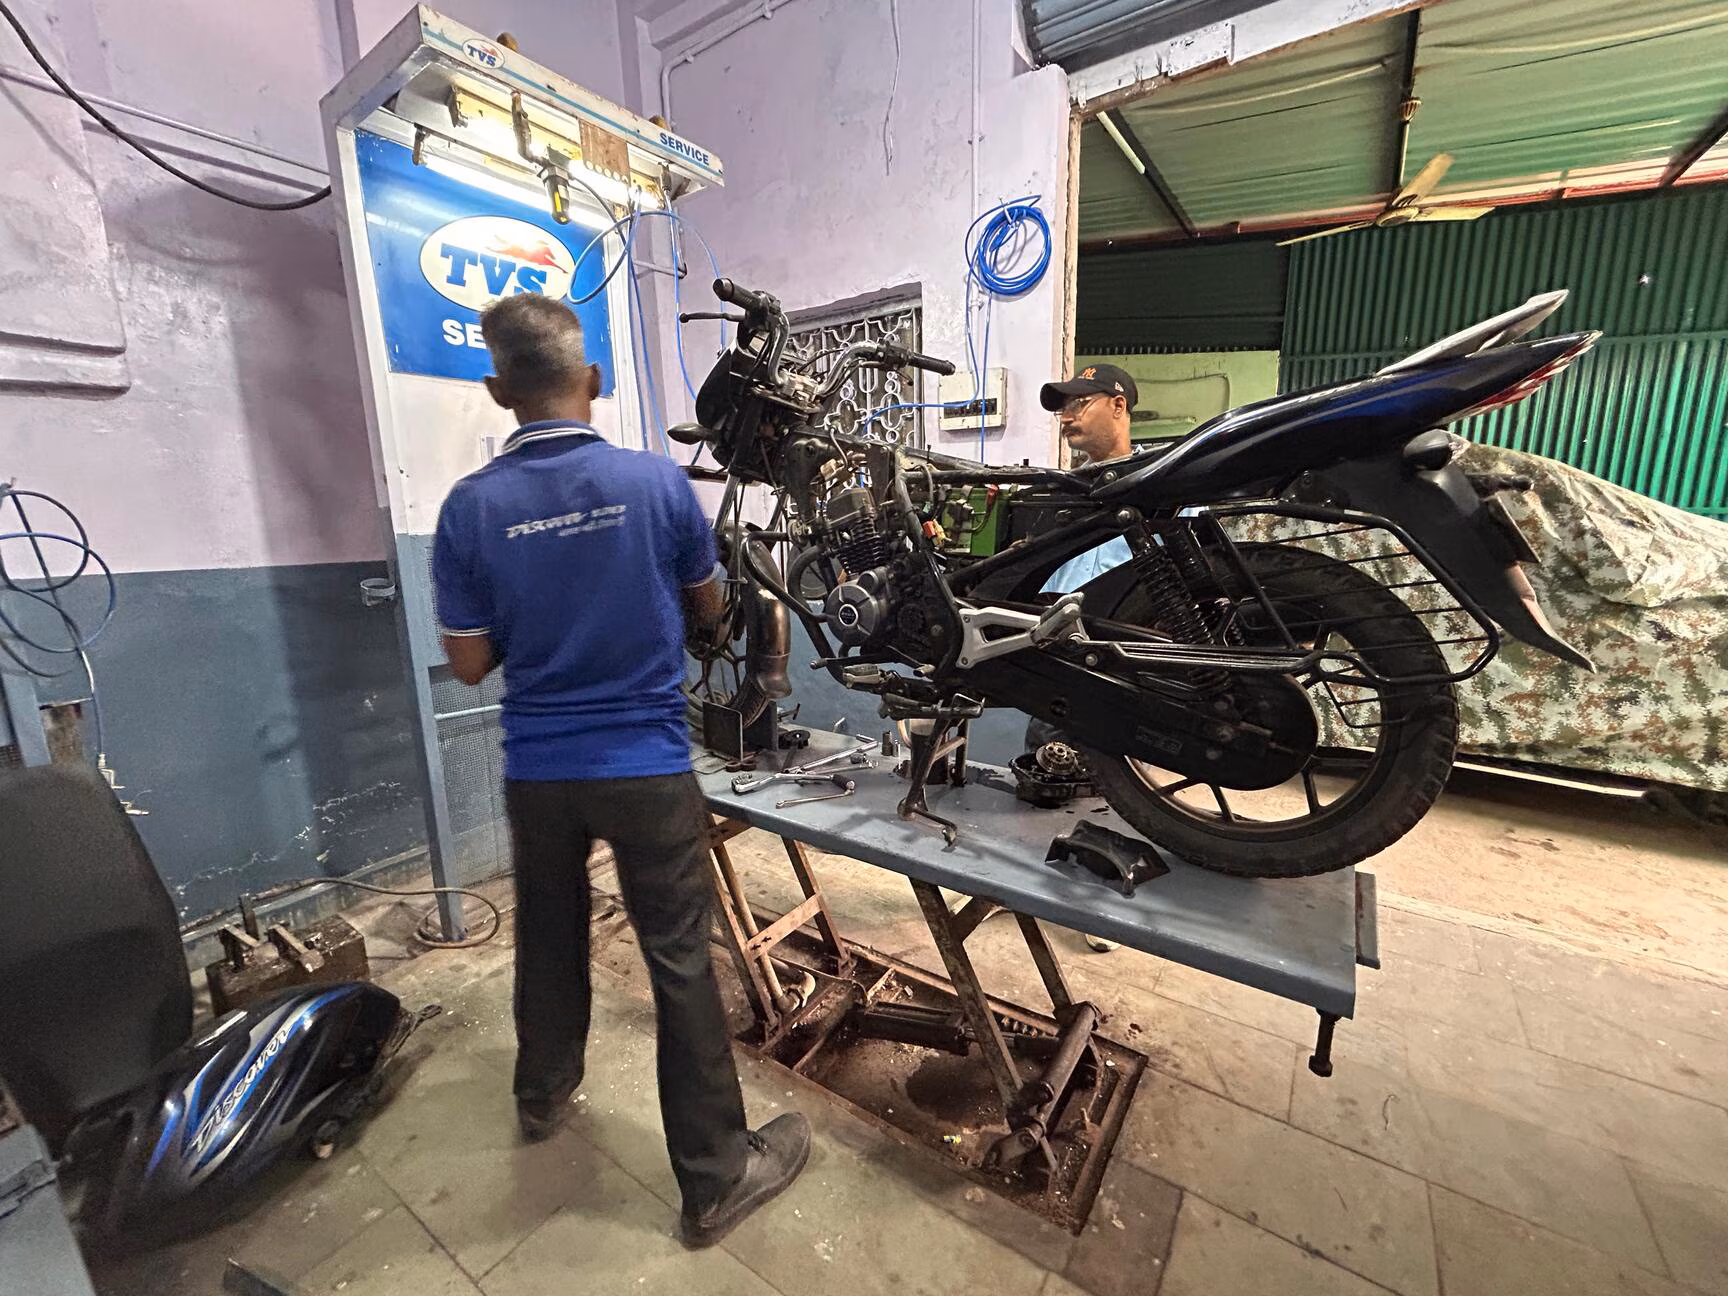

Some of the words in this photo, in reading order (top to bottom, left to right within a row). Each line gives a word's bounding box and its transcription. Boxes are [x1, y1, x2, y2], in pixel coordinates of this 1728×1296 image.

[467, 44, 497, 67] TVS
[660, 132, 709, 166] SERVICE
[440, 242, 548, 297] TVS
[191, 1029, 287, 1153] Discover
